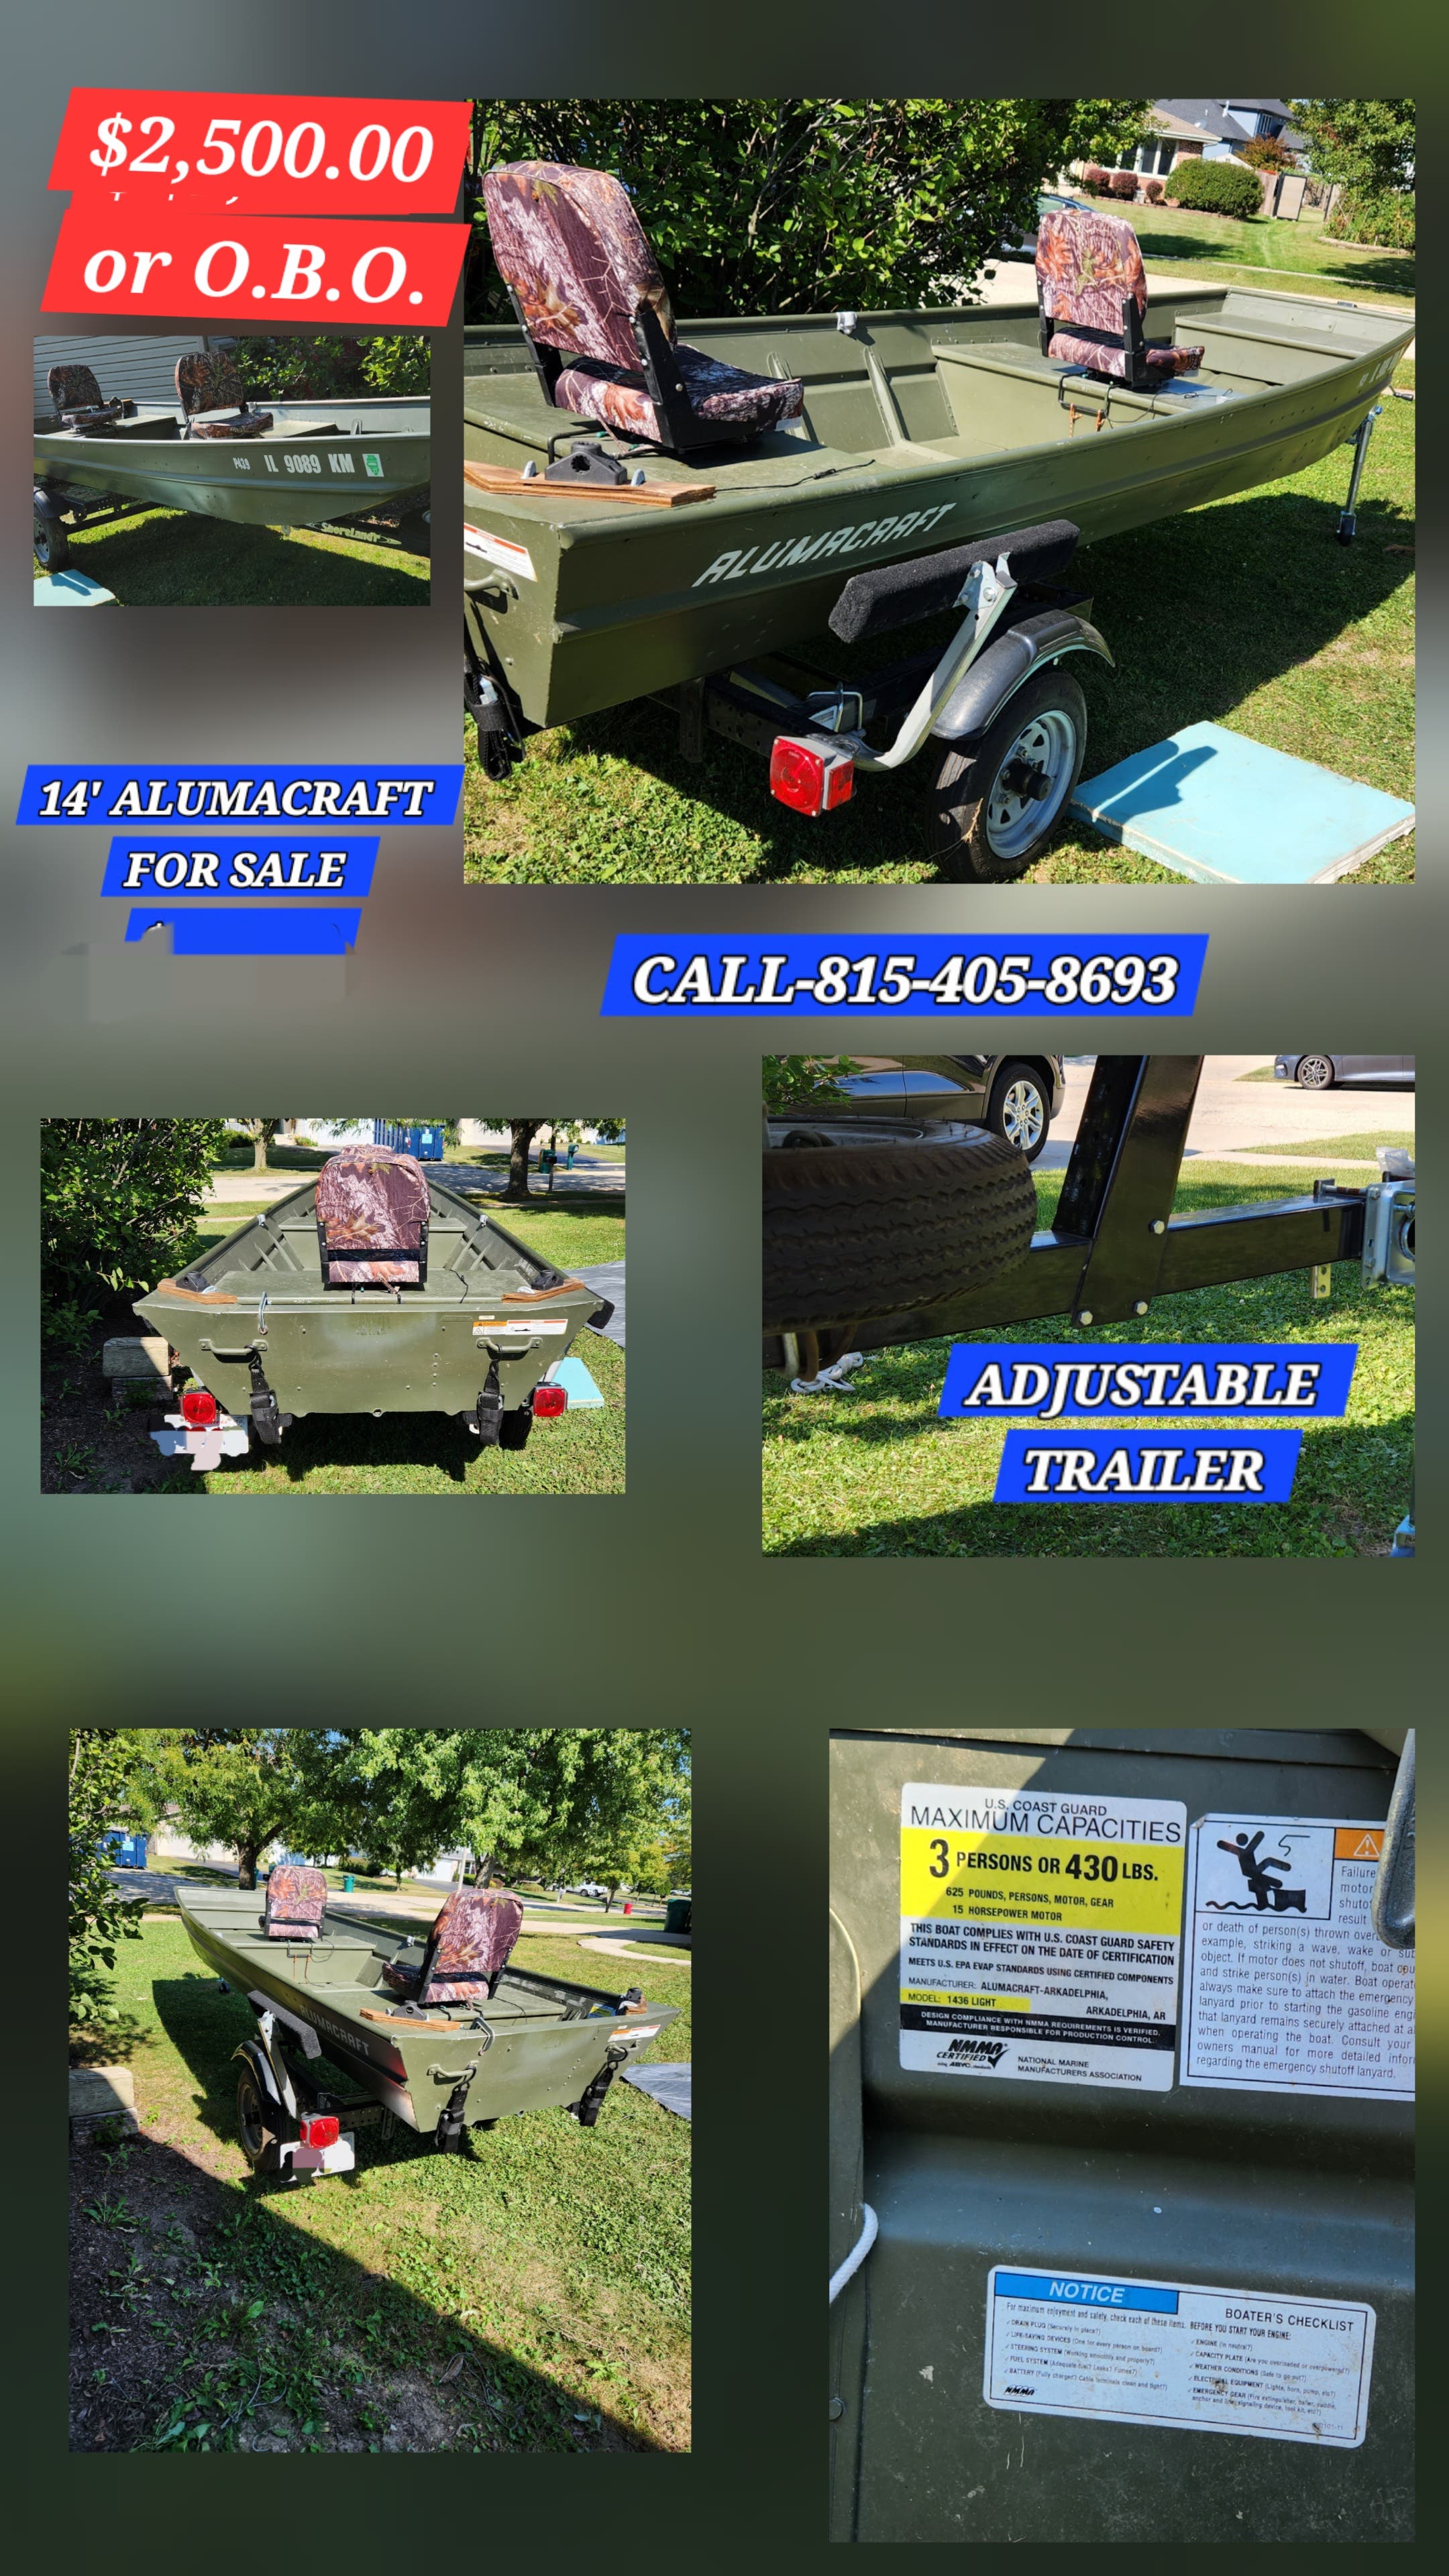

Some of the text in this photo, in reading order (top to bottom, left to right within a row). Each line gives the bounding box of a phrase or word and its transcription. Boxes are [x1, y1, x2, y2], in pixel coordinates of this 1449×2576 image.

[264, 455, 279, 472] IL
[284, 454, 321, 474] 9089
[328, 453, 355, 472] KM
[691, 502, 957, 588] ALUMACRAFT
[985, 1799, 1106, 1816] U.S. COAST GUARD
[911, 1806, 1180, 1842] MAXIMUM CAPACITIES
[929, 1839, 1159, 1882] 3 PERSONS OR 430 LBS.
[946, 1886, 1113, 1907] 625 POUNDS, PERSONS, MOTOR, GEAR
[953, 1904, 1061, 1921] 15 HORSEPOWER MOTOR
[910, 1923, 1174, 1951] THIS BOAT COMPLIES WITH U.S. COAST GUARD SAFETY
[909, 1937, 1174, 1965] STANDARDS IN EFFECT ON THE DATE OF CERTIFICATION
[1201, 1950, 1232, 1964] object.
[1238, 1952, 1244, 1962] If
[1248, 1955, 1278, 1965] motor
[1281, 1955, 1305, 1967] does
[1309, 1958, 1325, 1968] not
[1371, 1961, 1393, 1972] boat
[908, 1957, 1173, 1984] MEETS U.S. EPA EVAP STANDARDS USING CERTIFIED COMPONENTS
[1199, 1966, 1415, 1992] and strike person(s) in water. Boat operat
[908, 1977, 1108, 2000] MANUFACTURER: ALUMACRAFT-ARKADELPHIA,
[908, 1992, 996, 2006] MODEL: 1436 LIGHT
[1199, 1981, 1413, 2006] always make sure to attach the emergency
[1085, 2006, 1165, 2020] ARKADELPHIA, AR
[1199, 1995, 1234, 2008] lanyard
[1240, 2000, 1263, 2010] prior
[1269, 2000, 1278, 2010] to
[1284, 2002, 1321, 2015] starting
[1327, 2004, 1342, 2015] the
[1348, 2006, 1389, 2018] gasoline
[926, 2019, 987, 2030] MANUFACTURER
[990, 2025, 1042, 2034] RESPONSIBLE
[1063, 2030, 1113, 2039] PRODUCTION
[1116, 2035, 1155, 2043] CONTROL.
[951, 2013, 1001, 2023] COMPLIANCE
[1051, 2021, 1111, 2031] REQUIREMENTS
[1123, 2027, 1160, 2035] VERIFIED.
[1197, 2025, 1410, 2050] when operating the boat. Consult your
[936, 2051, 986, 2061] CERTIFIED
[1018, 2056, 1088, 2068] NATIONAL MARINE
[1197, 2042, 1233, 2053] owners
[1241, 2045, 1277, 2055] manual
[1285, 2045, 1299, 2056] for
[1307, 2049, 1333, 2059] more
[1341, 2049, 1380, 2062] detailed
[1018, 2065, 1141, 2081] MANUFACTURERS ASSOCIATION
[1197, 2056, 1395, 2079] regarding the emergency shutoff lanyard.
[1049, 2281, 1125, 2302] NOTICE
[1190, 2321, 1291, 2340] BEFORE YOU START YOUR ENGINE:
[1226, 2308, 1353, 2331] BOATER'S CHECKLIST
